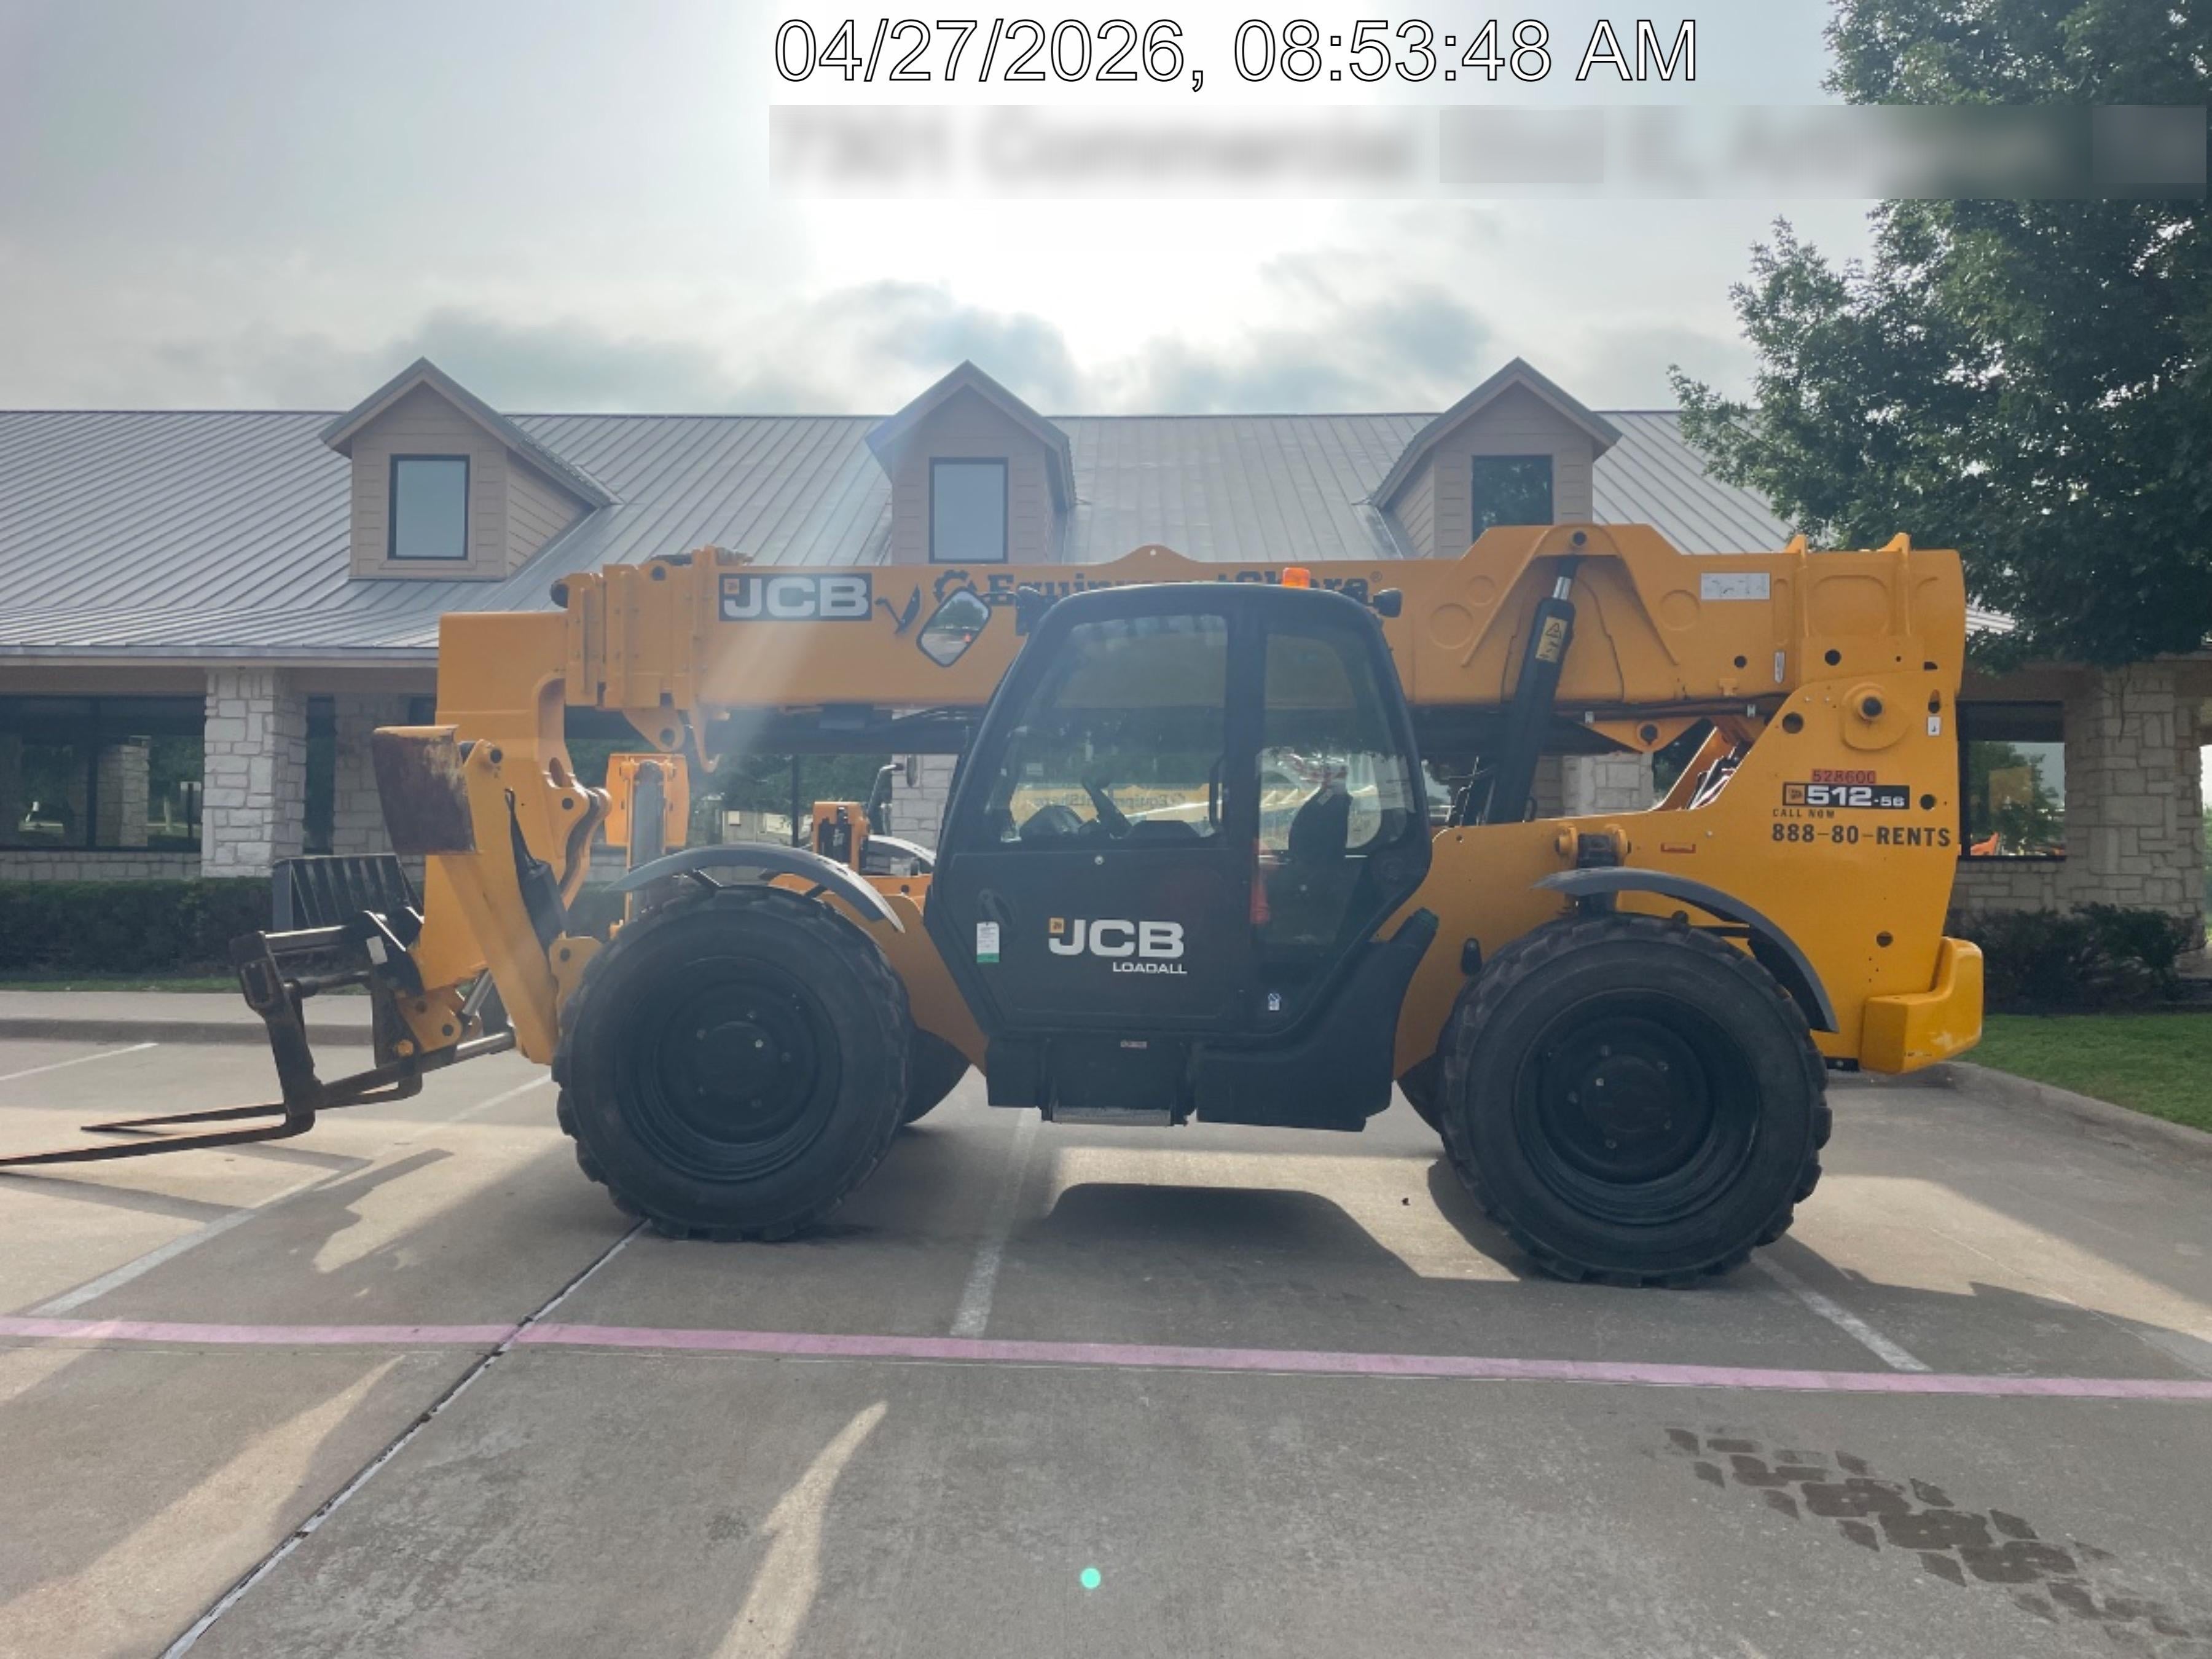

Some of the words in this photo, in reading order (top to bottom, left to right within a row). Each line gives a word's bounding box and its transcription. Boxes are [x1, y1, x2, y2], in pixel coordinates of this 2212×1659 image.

[724, 576, 869, 618] JCB
[1772, 809, 1803, 818] CALL
[1808, 809, 1835, 819] NOW
[1771, 823, 1951, 847] 888-80-RENTS
[1048, 919, 1185, 959] JCB
[1112, 962, 1188, 975] LOADALL
